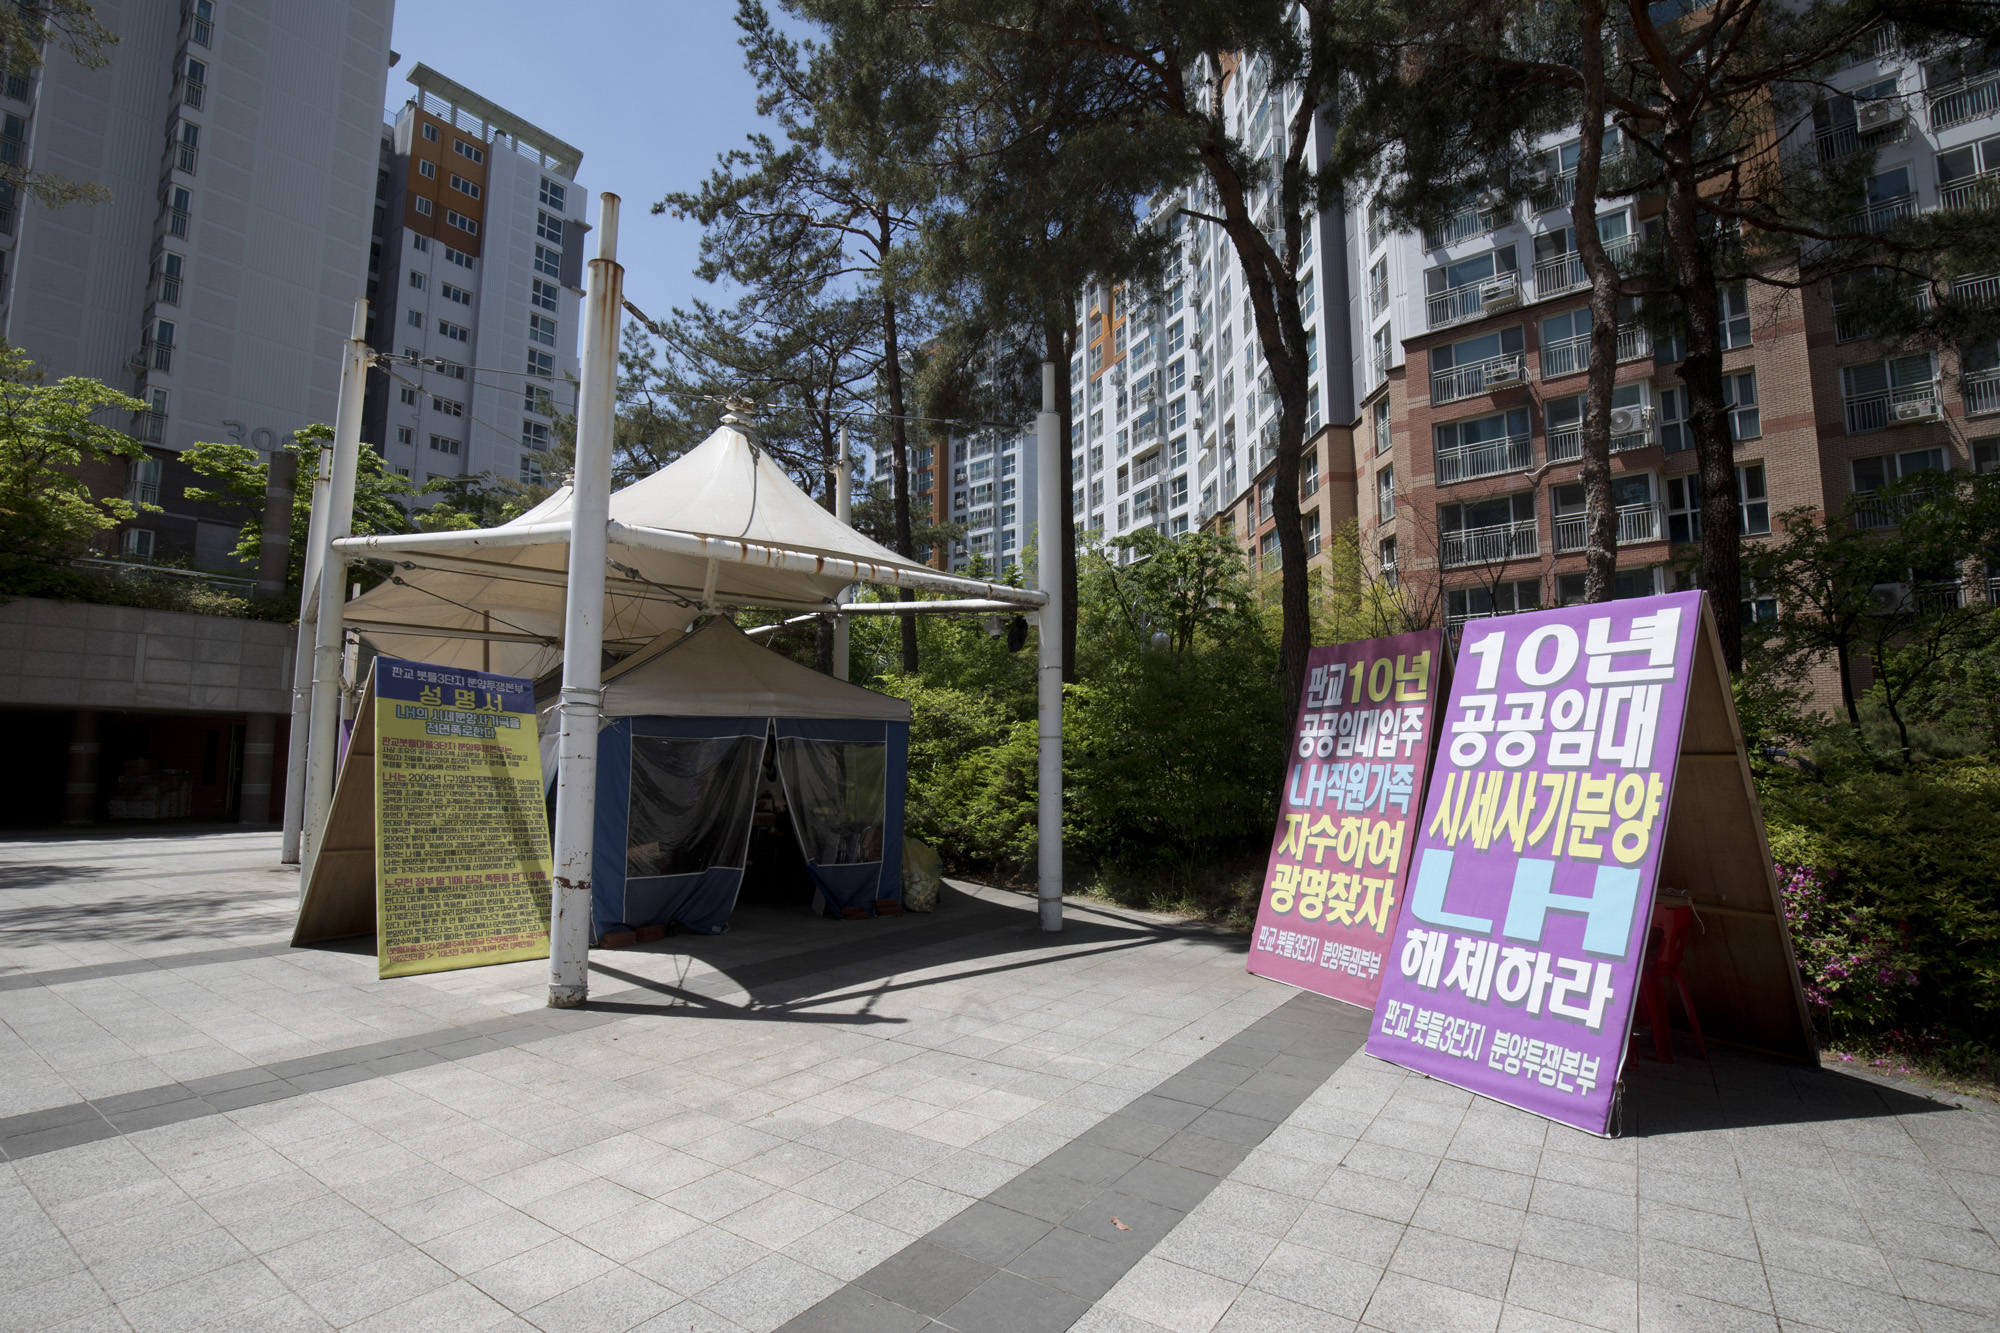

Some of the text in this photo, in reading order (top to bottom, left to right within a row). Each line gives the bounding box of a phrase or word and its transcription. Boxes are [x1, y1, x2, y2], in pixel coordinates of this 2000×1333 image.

[1469, 607, 1682, 689] 10년
[392, 666, 524, 694] 판교 봇들3단지 분양투쟁본부
[1308, 650, 1429, 706] 판교 10년
[396, 704, 521, 729] LH의 시세분양사기극을
[426, 721, 496, 739] 전면폭로한다
[1299, 707, 1424, 758] 공공임대입주
[1449, 685, 1663, 767] 공공임대
[383, 772, 406, 783] LH는
[409, 773, 441, 784] 2006년
[1289, 763, 1414, 814] LH직원가족
[1278, 813, 1403, 873] 자수하여
[1428, 771, 1663, 864] 시세사기분양
[385, 878, 413, 888] 노무현
[416, 877, 434, 887] 정부
[1271, 865, 1394, 933] 광명찾자
[1412, 848, 1640, 956] LH
[1257, 925, 1382, 978] 판교 봇들3단지 분양투쟁본부
[1401, 929, 1613, 1028] 해체하라
[1383, 999, 1600, 1094] 판교 봇들3단지 분양투쟁본부
